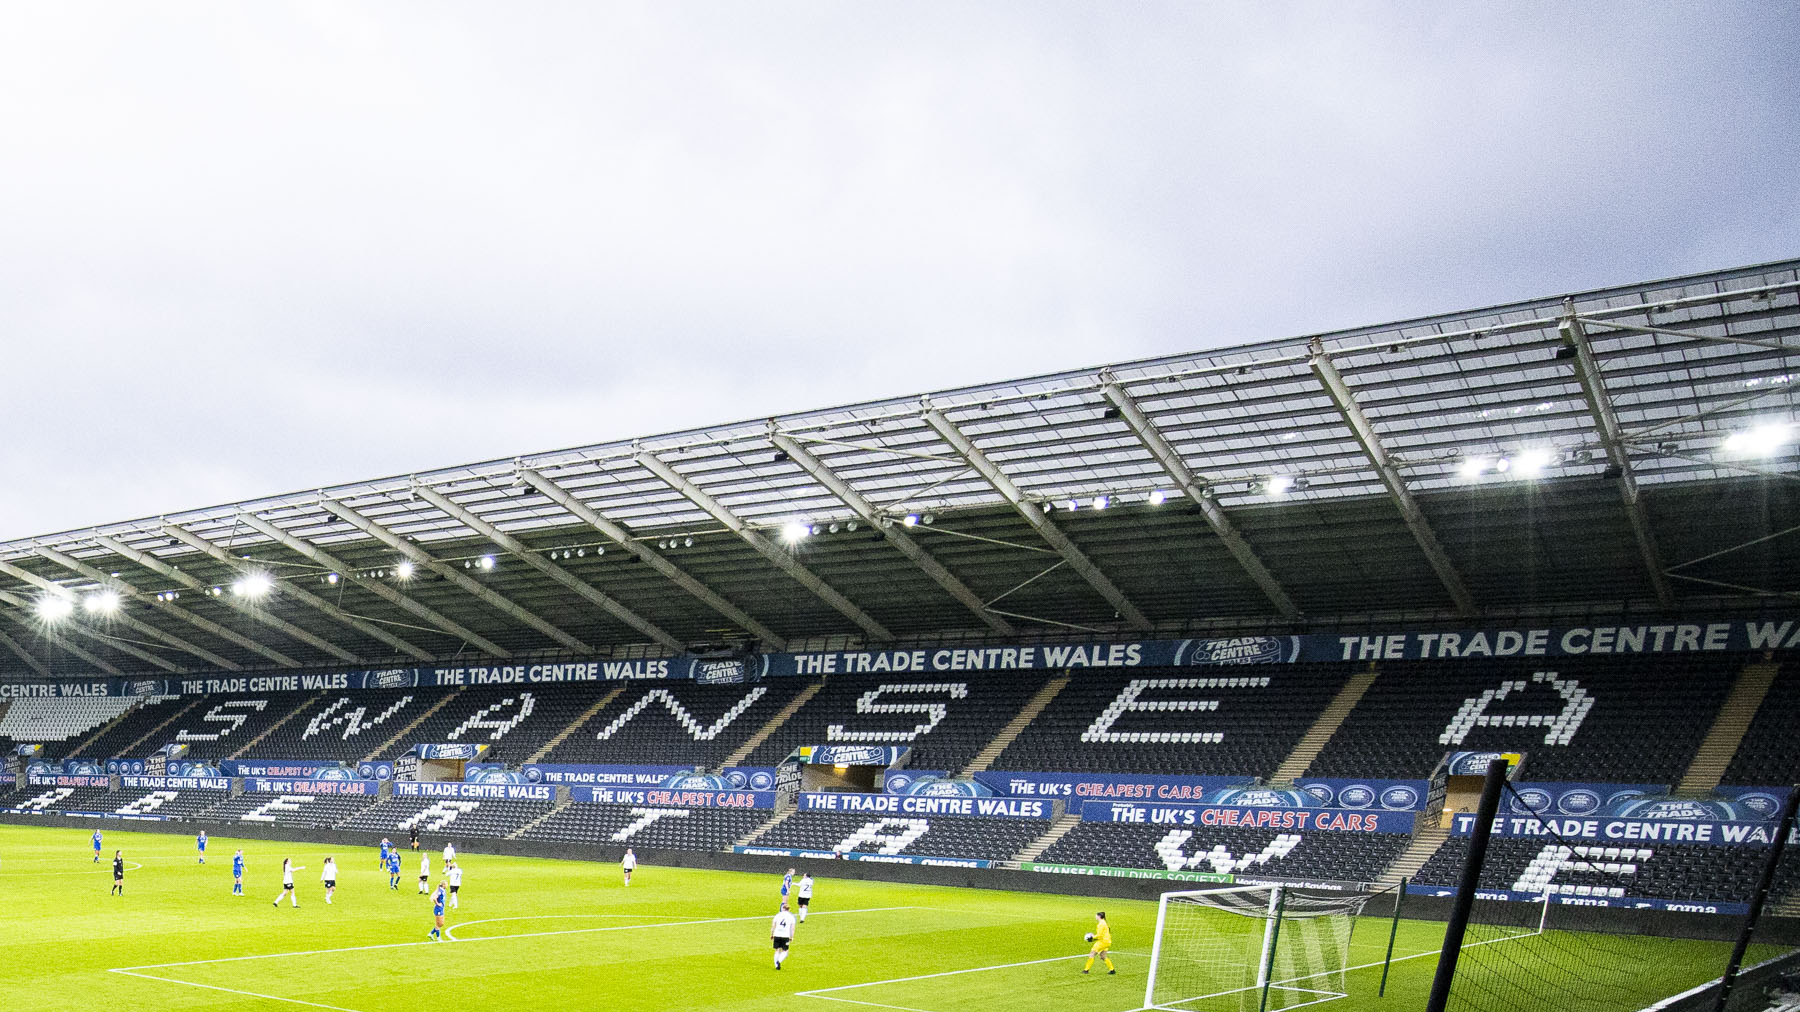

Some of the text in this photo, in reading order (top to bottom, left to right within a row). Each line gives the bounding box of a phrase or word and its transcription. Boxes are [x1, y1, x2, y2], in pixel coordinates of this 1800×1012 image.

[1205, 637, 1267, 649] TRADE
[1339, 622, 1731, 660] THE TRADE CENTRE
[795, 644, 1142, 674] THE TRADE CENTRE WALES
[1210, 646, 1262, 659] CENTRE
[702, 660, 742, 670] TRADE
[435, 660, 669, 686] THE TRADE CENTRE WALES
[705, 668, 739, 680] CENTRE
[0, 684, 56, 697] CENTRE
[60, 683, 108, 697] WALES
[182, 674, 348, 695] THE TRADE CENTRE WALES
[834, 751, 869, 763] CENTRE
[251, 768, 266, 776] UK'S
[267, 768, 300, 777] CHEAPEST
[545, 772, 562, 782] THE
[565, 773, 595, 782] TRADE
[598, 773, 633, 783] CENTRE
[29, 776, 108, 786] THE UK'S CHEAPEST CARS
[124, 777, 228, 789] THE TRADE CENTRE WALES
[256, 781, 365, 794] THE UK'S CHEAPEST CARS
[398, 784, 550, 799] THE TRADE CENTRE WALES
[1010, 783, 1203, 799] THE UK'S CHEAPEST CARS
[592, 790, 755, 808] THE UK'S CHEAPEST CARS
[807, 794, 1043, 818] THE TRADE CENTRE WALES
[1111, 807, 1378, 832] THE UK'S CHEAPEST CARS
[1648, 809, 1705, 819] TRADE
[1458, 816, 1713, 842] TE TRADE CENTRE
[780, 918, 787, 928] 4
